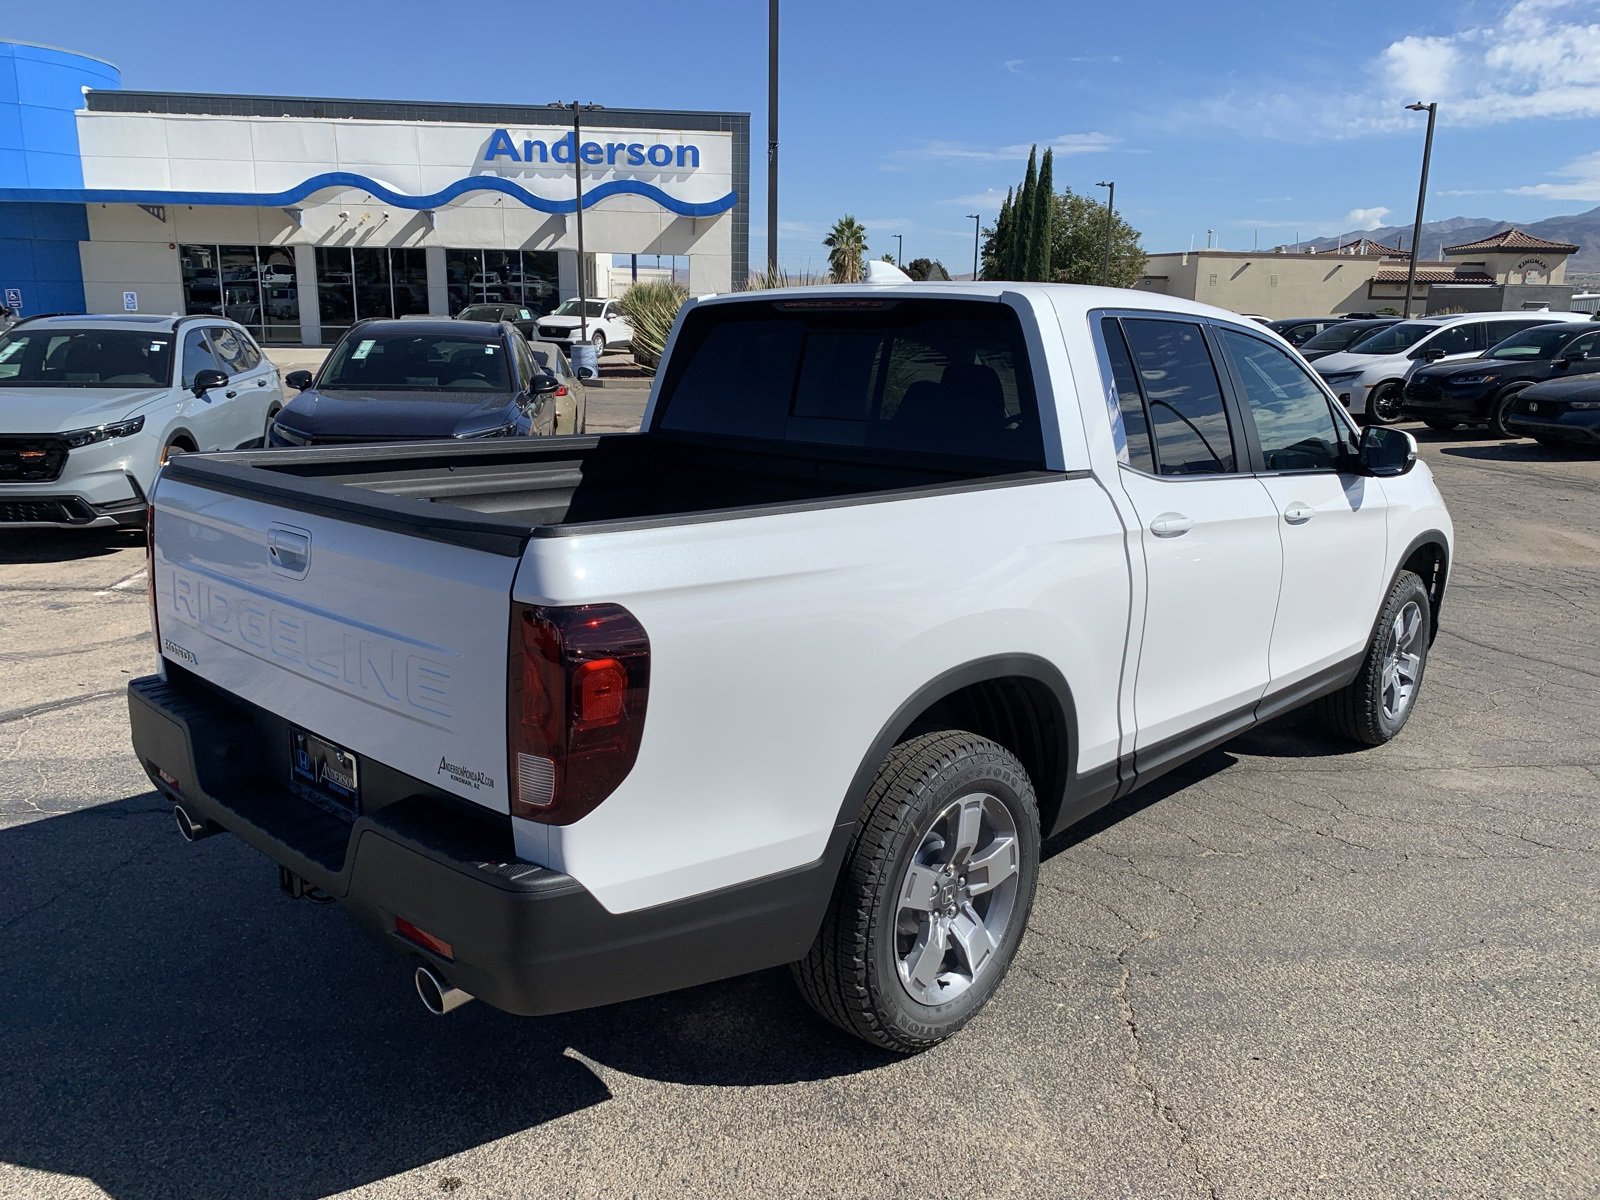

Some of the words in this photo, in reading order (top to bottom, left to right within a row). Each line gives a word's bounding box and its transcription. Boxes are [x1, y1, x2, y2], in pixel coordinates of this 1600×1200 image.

[484, 128, 700, 168] Anderson
[1518, 258, 1548, 270] KINGMAN
[164, 638, 199, 665] HONDA
[172, 570, 452, 718] RIDGELINE
[319, 761, 355, 789] ANDERSON
